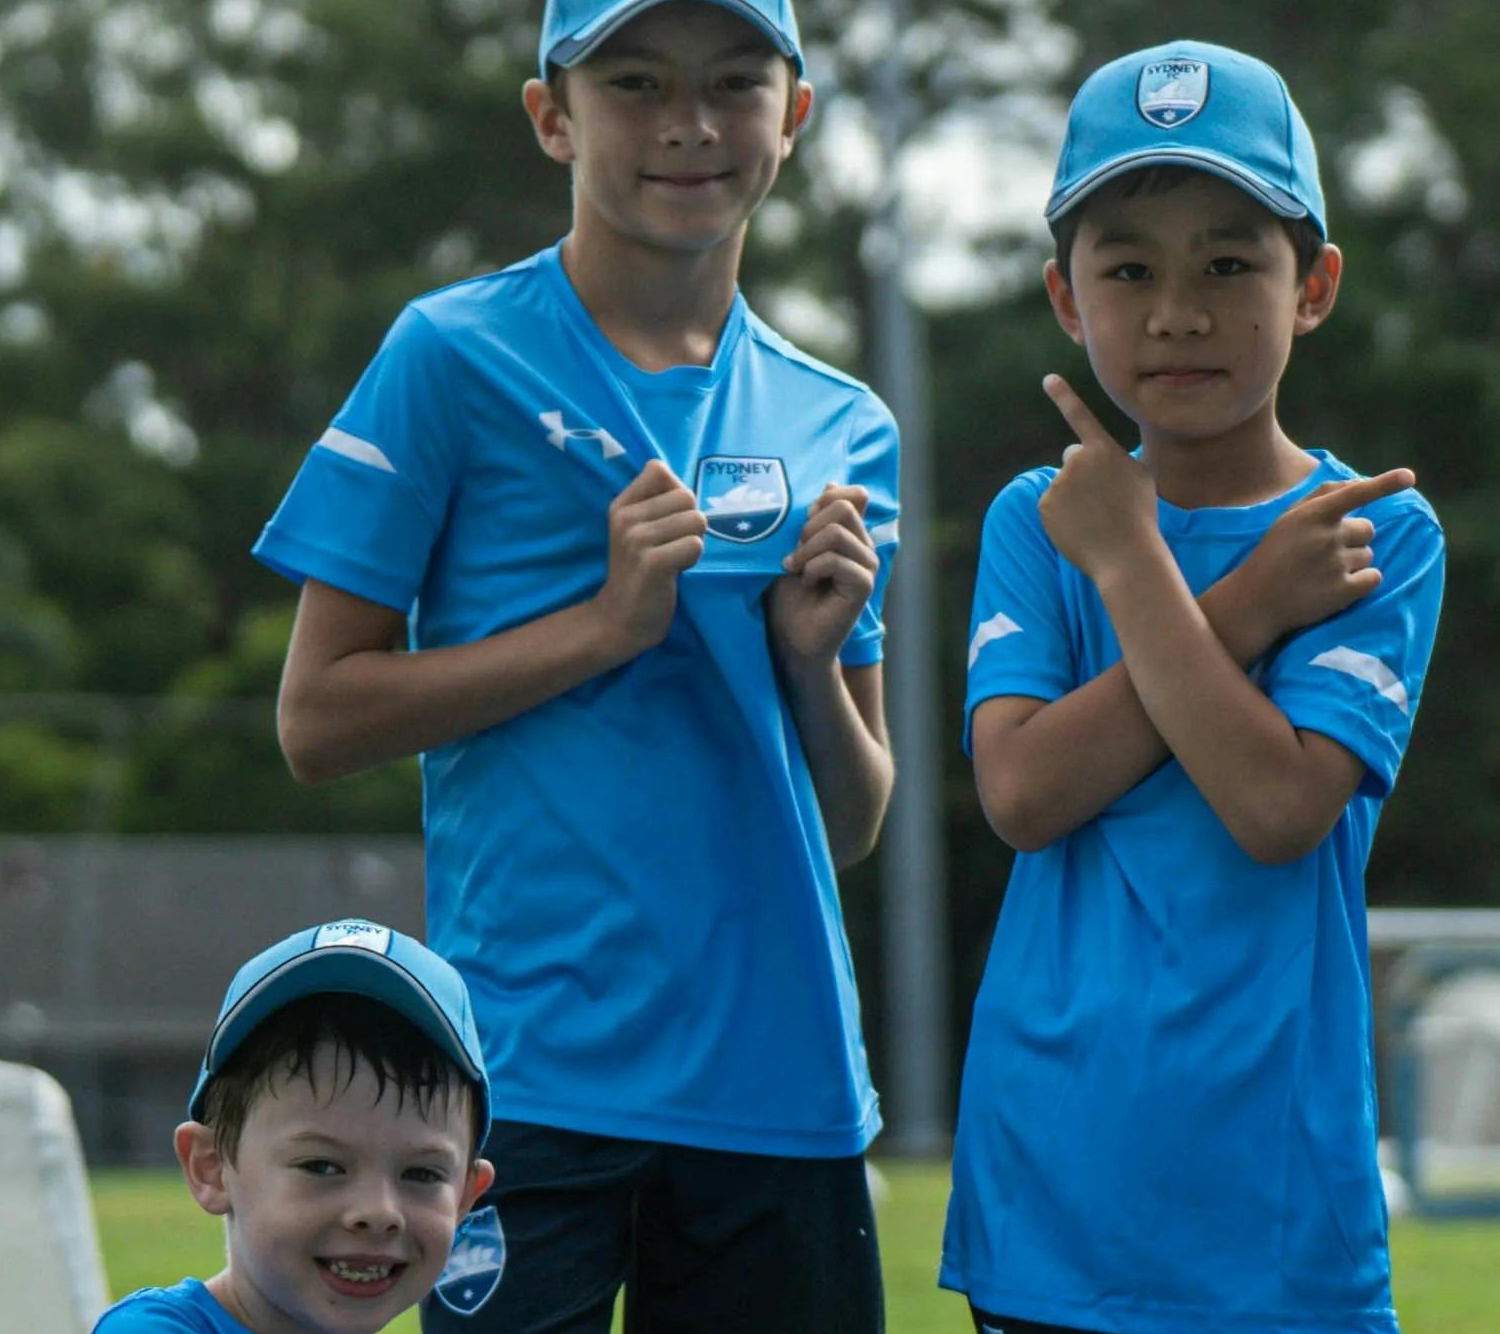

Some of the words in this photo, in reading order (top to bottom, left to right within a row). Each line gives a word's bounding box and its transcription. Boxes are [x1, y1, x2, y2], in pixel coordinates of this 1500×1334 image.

[1147, 63, 1200, 75] SYDNEY
[705, 462, 772, 475] SYDNEY
[731, 474, 749, 483] FC
